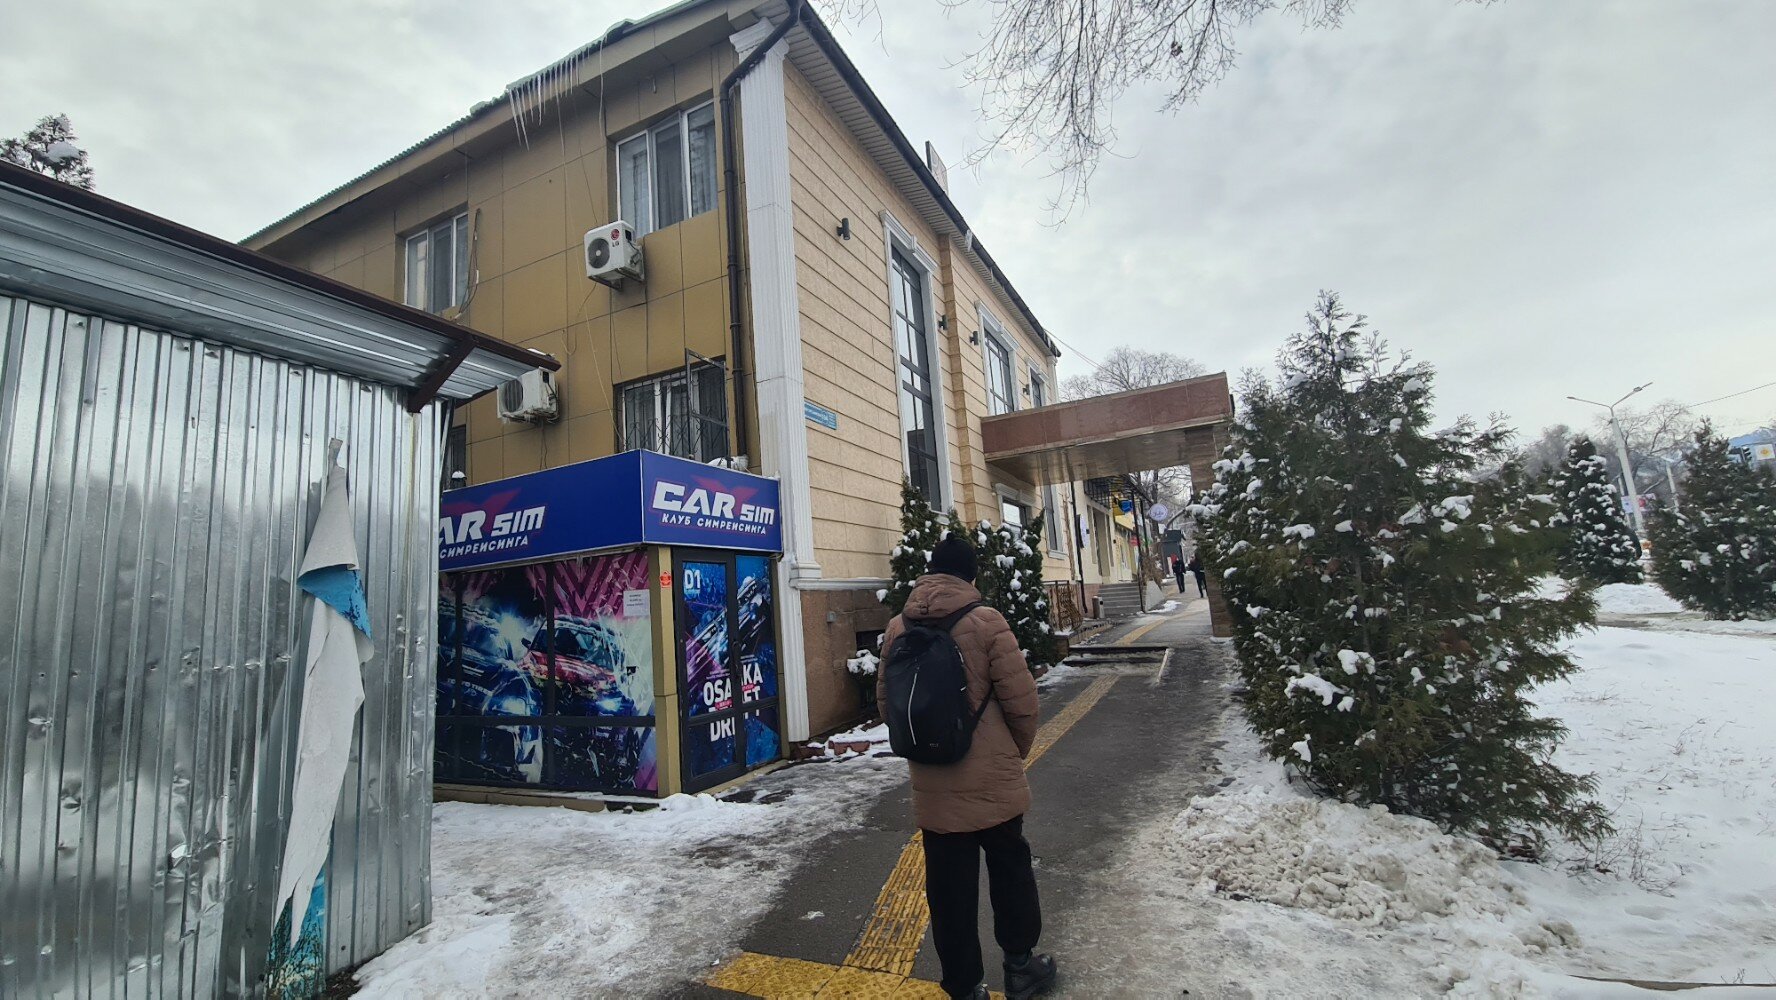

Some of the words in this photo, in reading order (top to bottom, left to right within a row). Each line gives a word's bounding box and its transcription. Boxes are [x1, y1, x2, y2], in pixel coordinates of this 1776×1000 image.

[652, 481, 736, 520] CAR
[438, 510, 487, 546] AR
[662, 513, 691, 526] КЛУБ
[684, 568, 701, 588] D1
[703, 662, 764, 706] OSAKA
